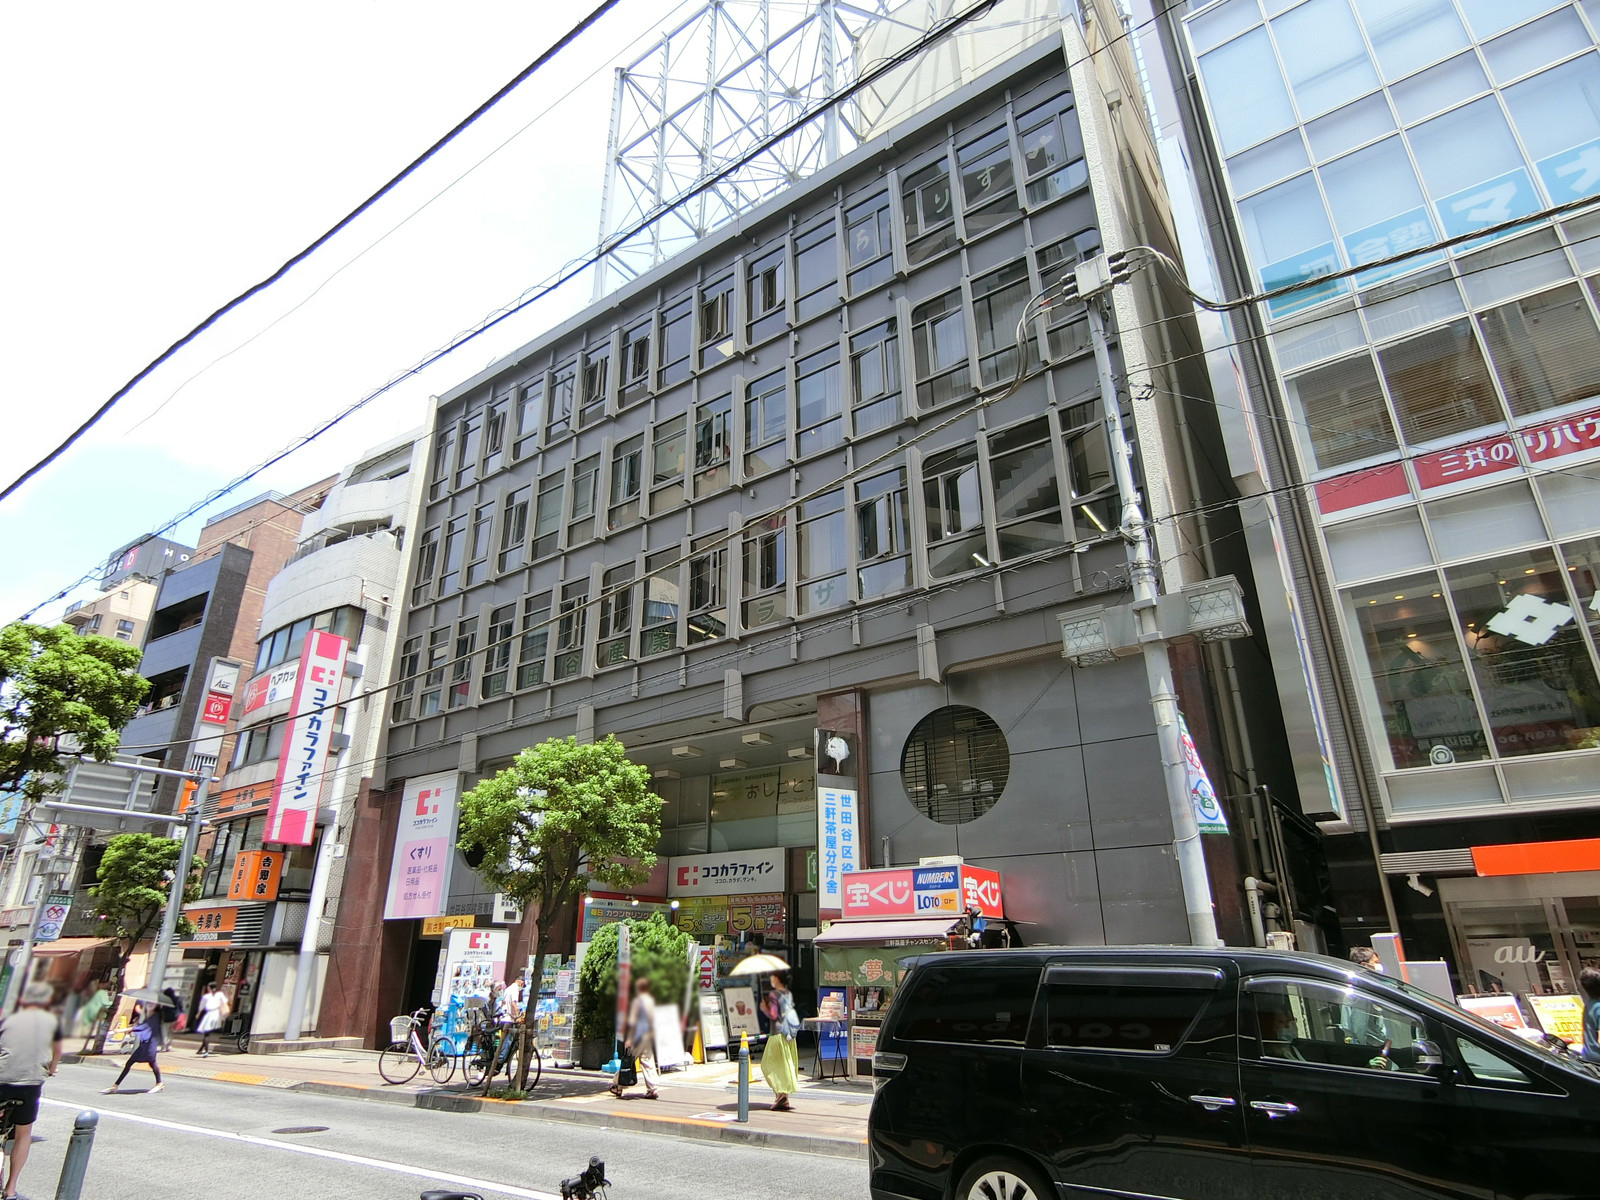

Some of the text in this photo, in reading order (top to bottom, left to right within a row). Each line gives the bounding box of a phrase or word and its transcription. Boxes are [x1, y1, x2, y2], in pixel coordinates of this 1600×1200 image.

[293, 688, 328, 800] ココカラファイン
[412, 817, 438, 827] ココカラファイン
[410, 845, 432, 860] くすり
[824, 793, 838, 895] 三軒茶屋分庁舎
[256, 856, 273, 894] 吉野家
[702, 861, 774, 878] ココカラファイン
[917, 871, 955, 885] NUMBERS
[846, 880, 910, 907] 宝くじ
[963, 876, 1000, 907] 宝くじ
[917, 894, 940, 910] LOTO
[1494, 945, 1546, 964] au
